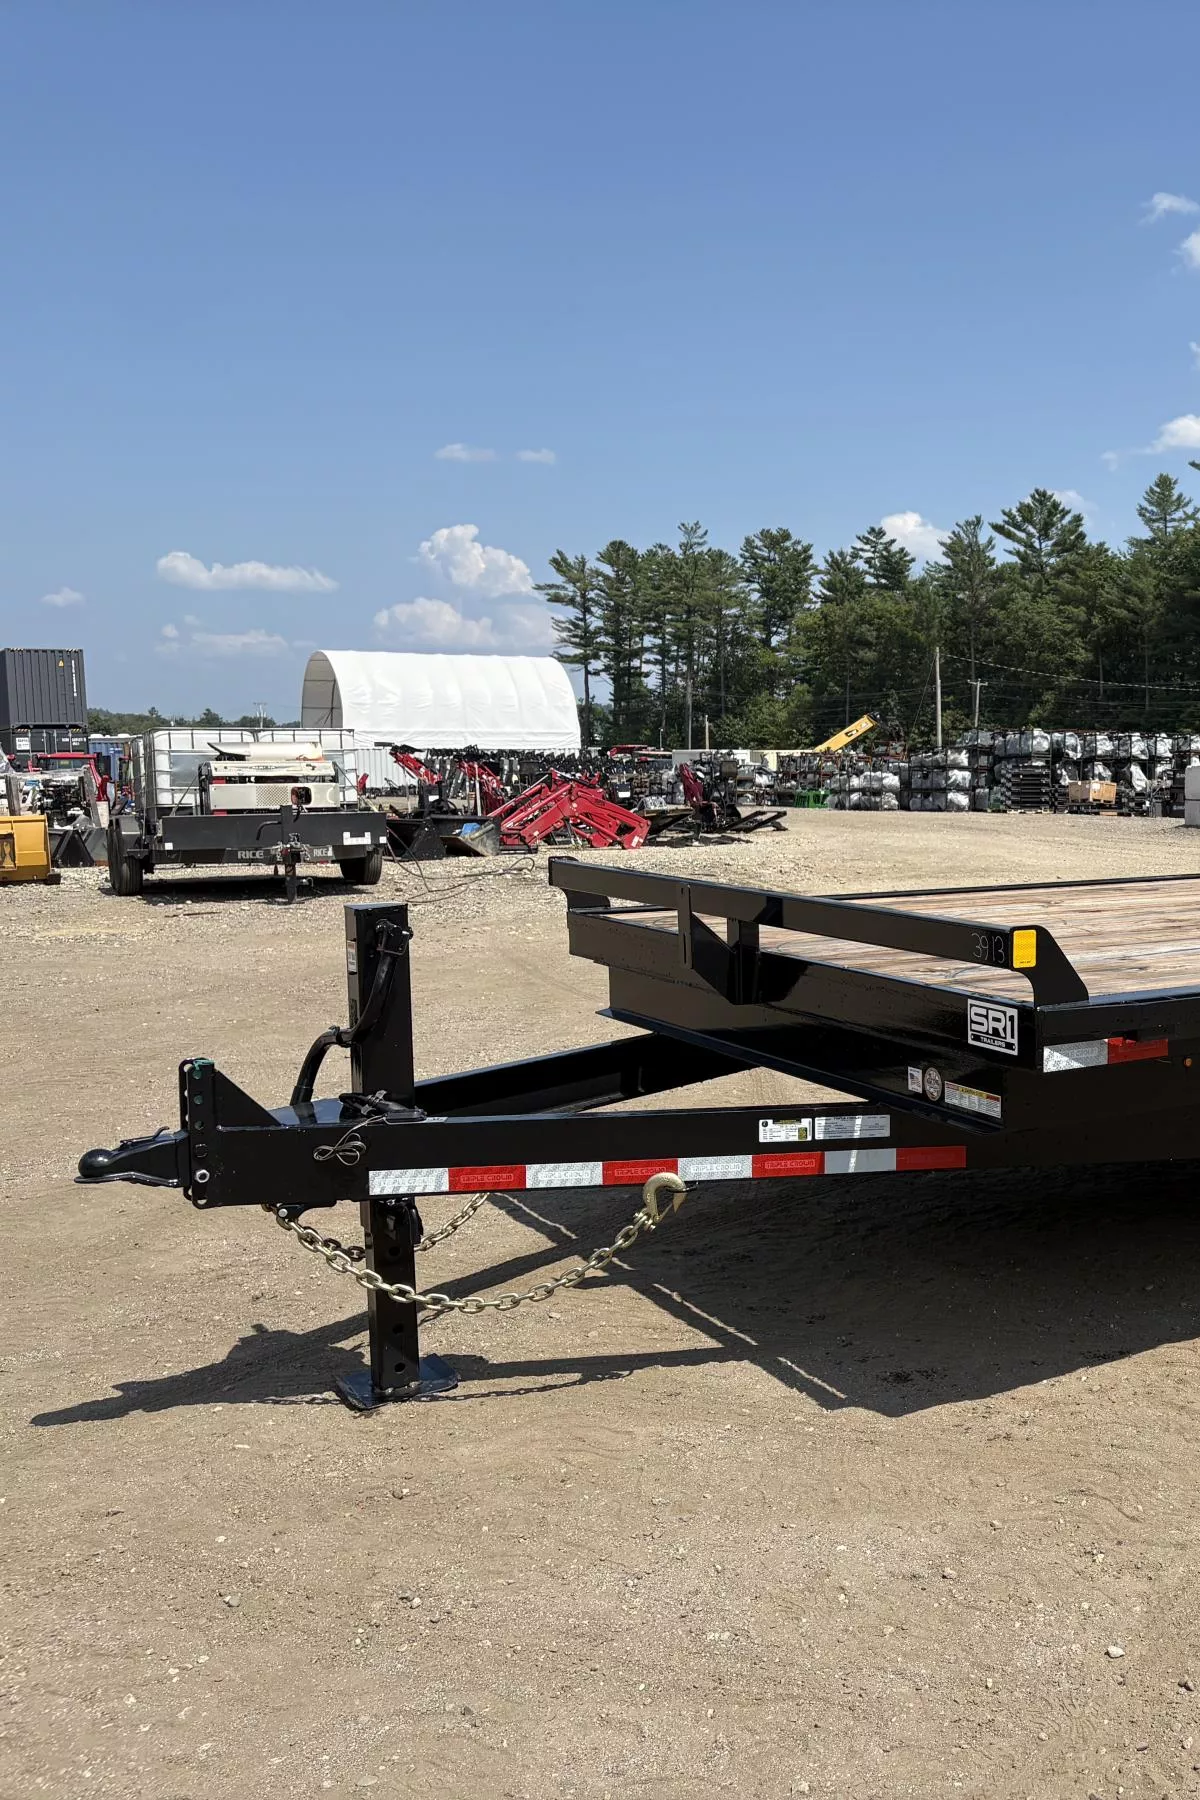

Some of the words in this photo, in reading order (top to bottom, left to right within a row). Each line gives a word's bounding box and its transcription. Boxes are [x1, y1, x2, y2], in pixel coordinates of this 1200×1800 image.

[238, 850, 264, 859] RICE
[971, 932, 1005, 964] 3913
[980, 1036, 1006, 1048] TRAILERS
[766, 1161, 788, 1169] TRIPLE
[789, 1160, 815, 1168] CROWN
[462, 1175, 485, 1183] TRIPLE
[486, 1174, 513, 1182] CROWN
